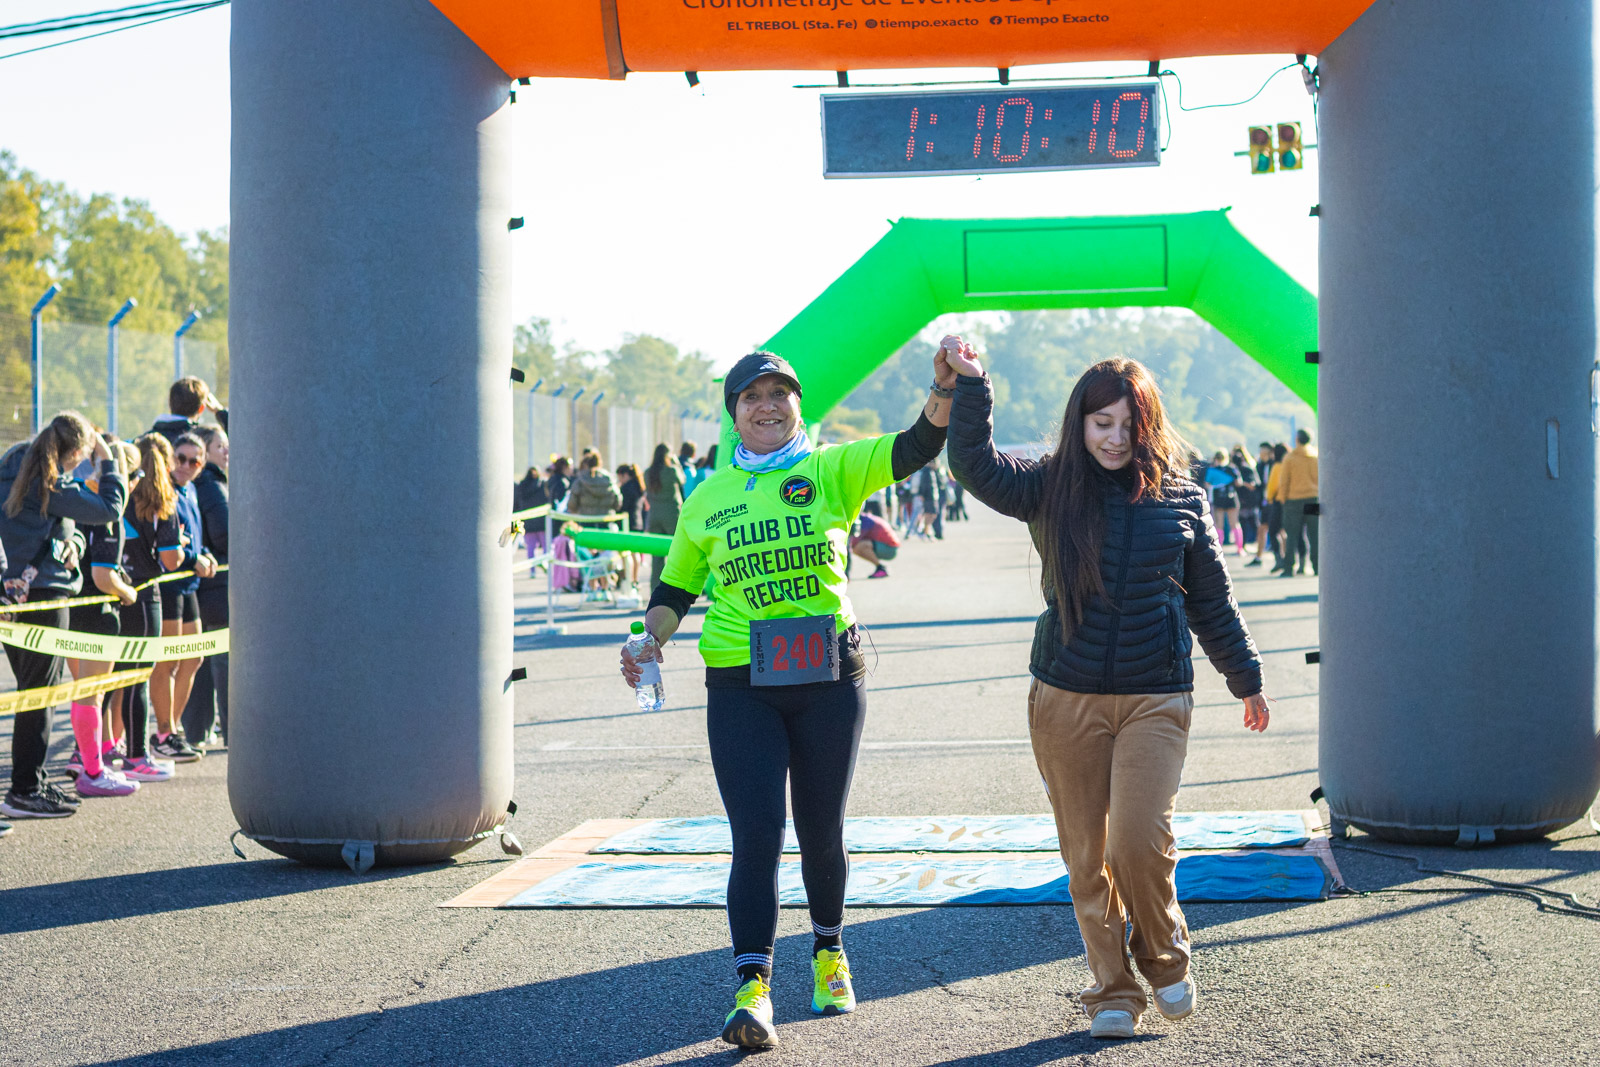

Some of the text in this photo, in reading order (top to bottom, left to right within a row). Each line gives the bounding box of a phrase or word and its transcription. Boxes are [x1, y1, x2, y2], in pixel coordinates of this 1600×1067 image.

[727, 13, 1109, 31] EL TREBOL (Sta. Fe) tiempo.exacto Tiempo Exacto
[705, 503, 748, 528] EMAPUR
[726, 514, 815, 551] CLUB DE
[718, 540, 835, 587] CORREDORES
[743, 574, 820, 610] RECREO
[55, 638, 216, 655] PRECAUCION PRECAUCION
[755, 632, 765, 673] TIEMPO
[771, 632, 824, 671] 240
[825, 628, 834, 669] EXACTO
[830, 980, 844, 990] 240
